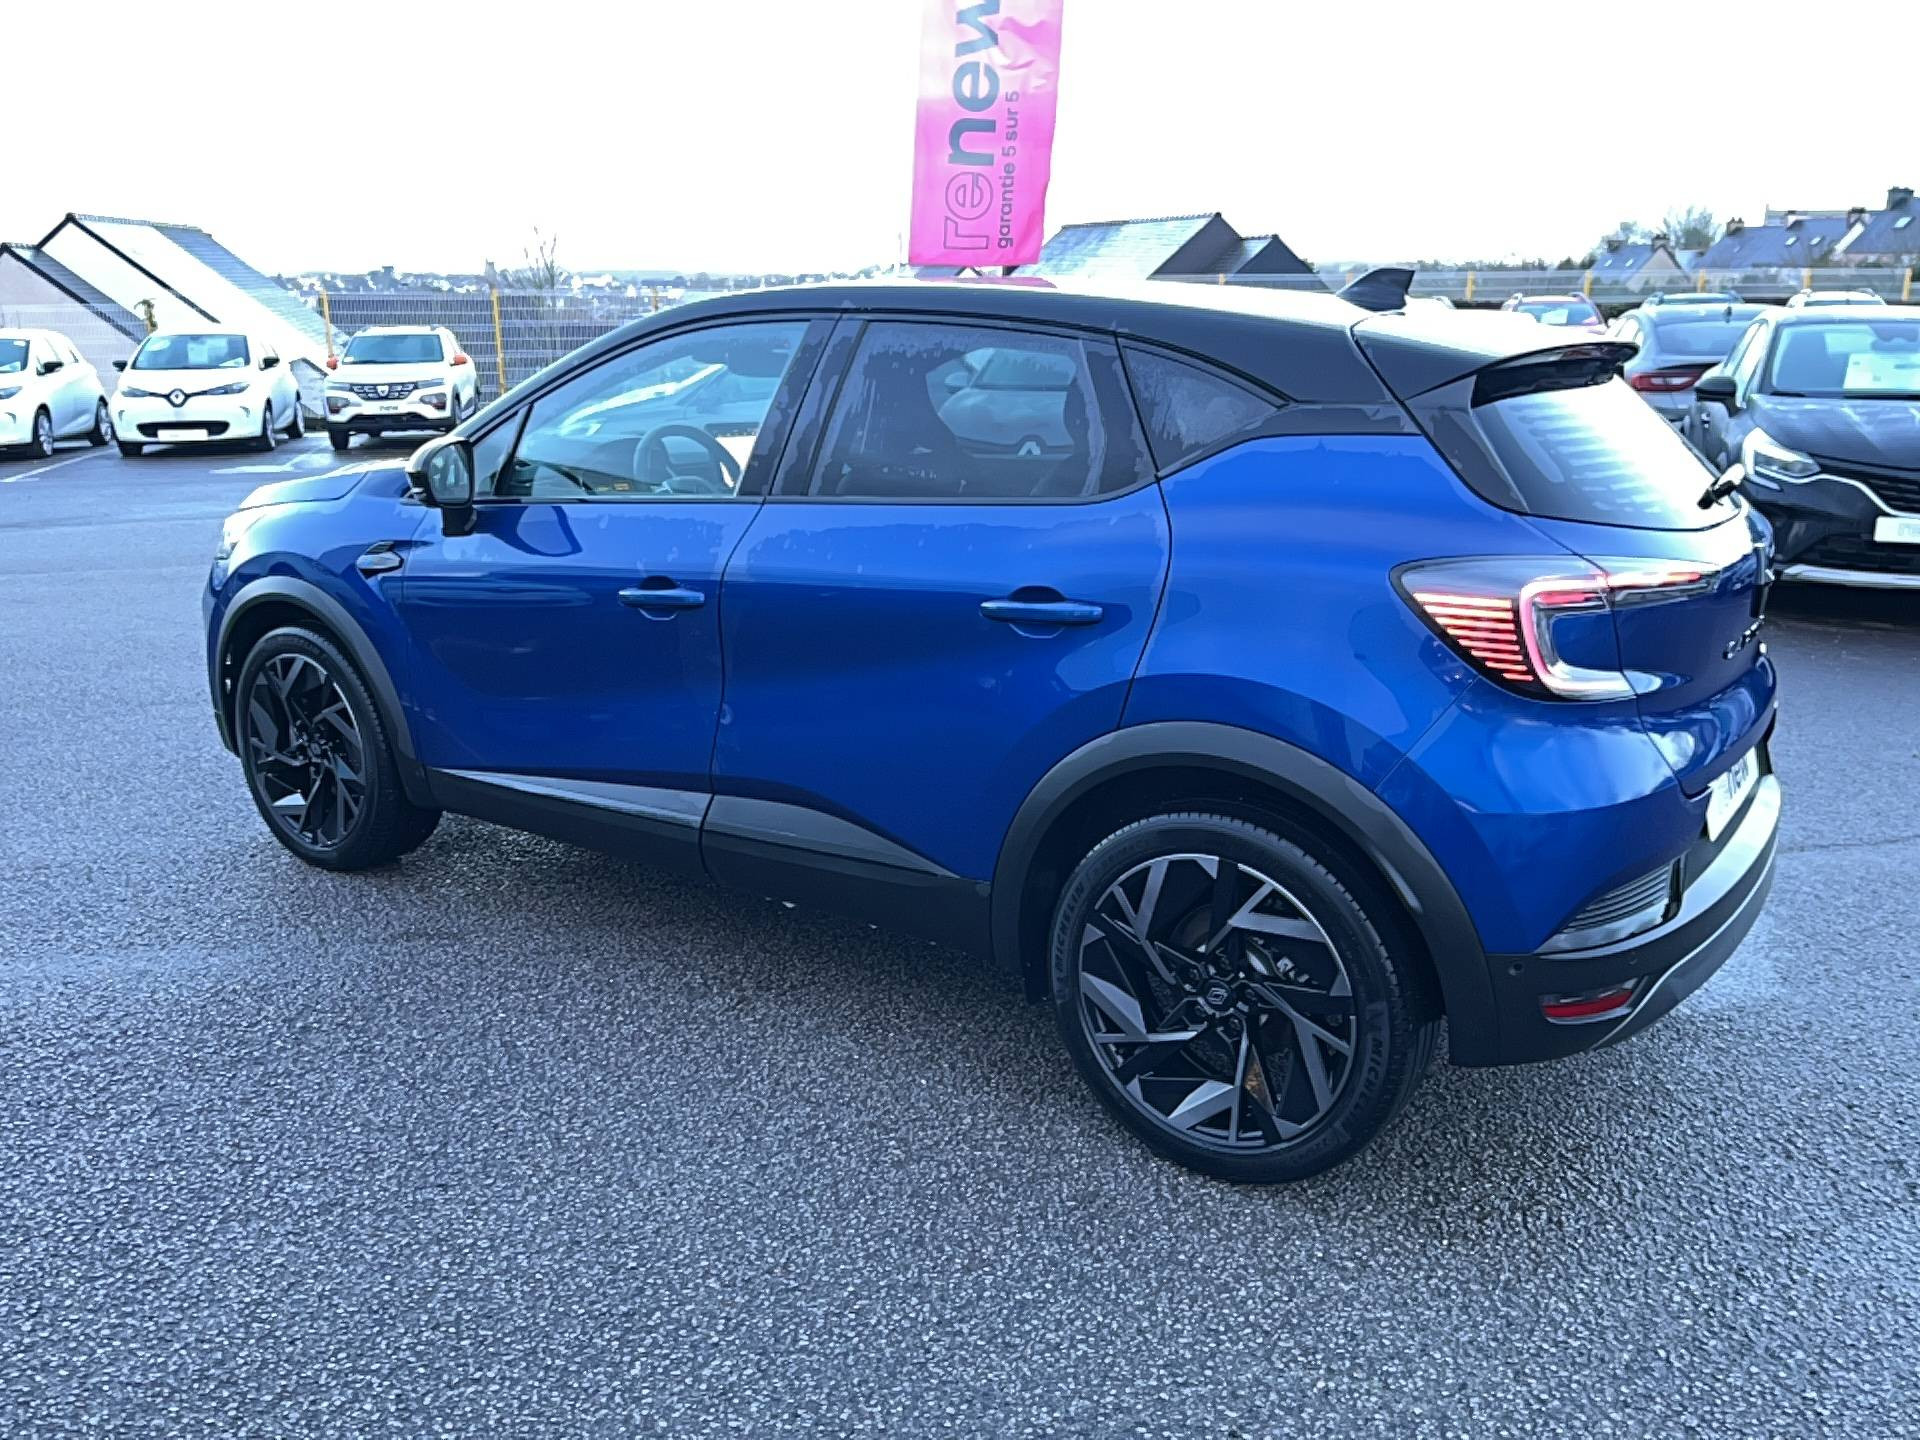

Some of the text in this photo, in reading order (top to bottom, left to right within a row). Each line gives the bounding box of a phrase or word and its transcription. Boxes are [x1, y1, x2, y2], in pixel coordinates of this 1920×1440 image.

[944, 0, 1000, 250] renew
[998, 90, 1020, 249] garantie 5 sur 5
[1055, 882, 1084, 972] MICHELIN
